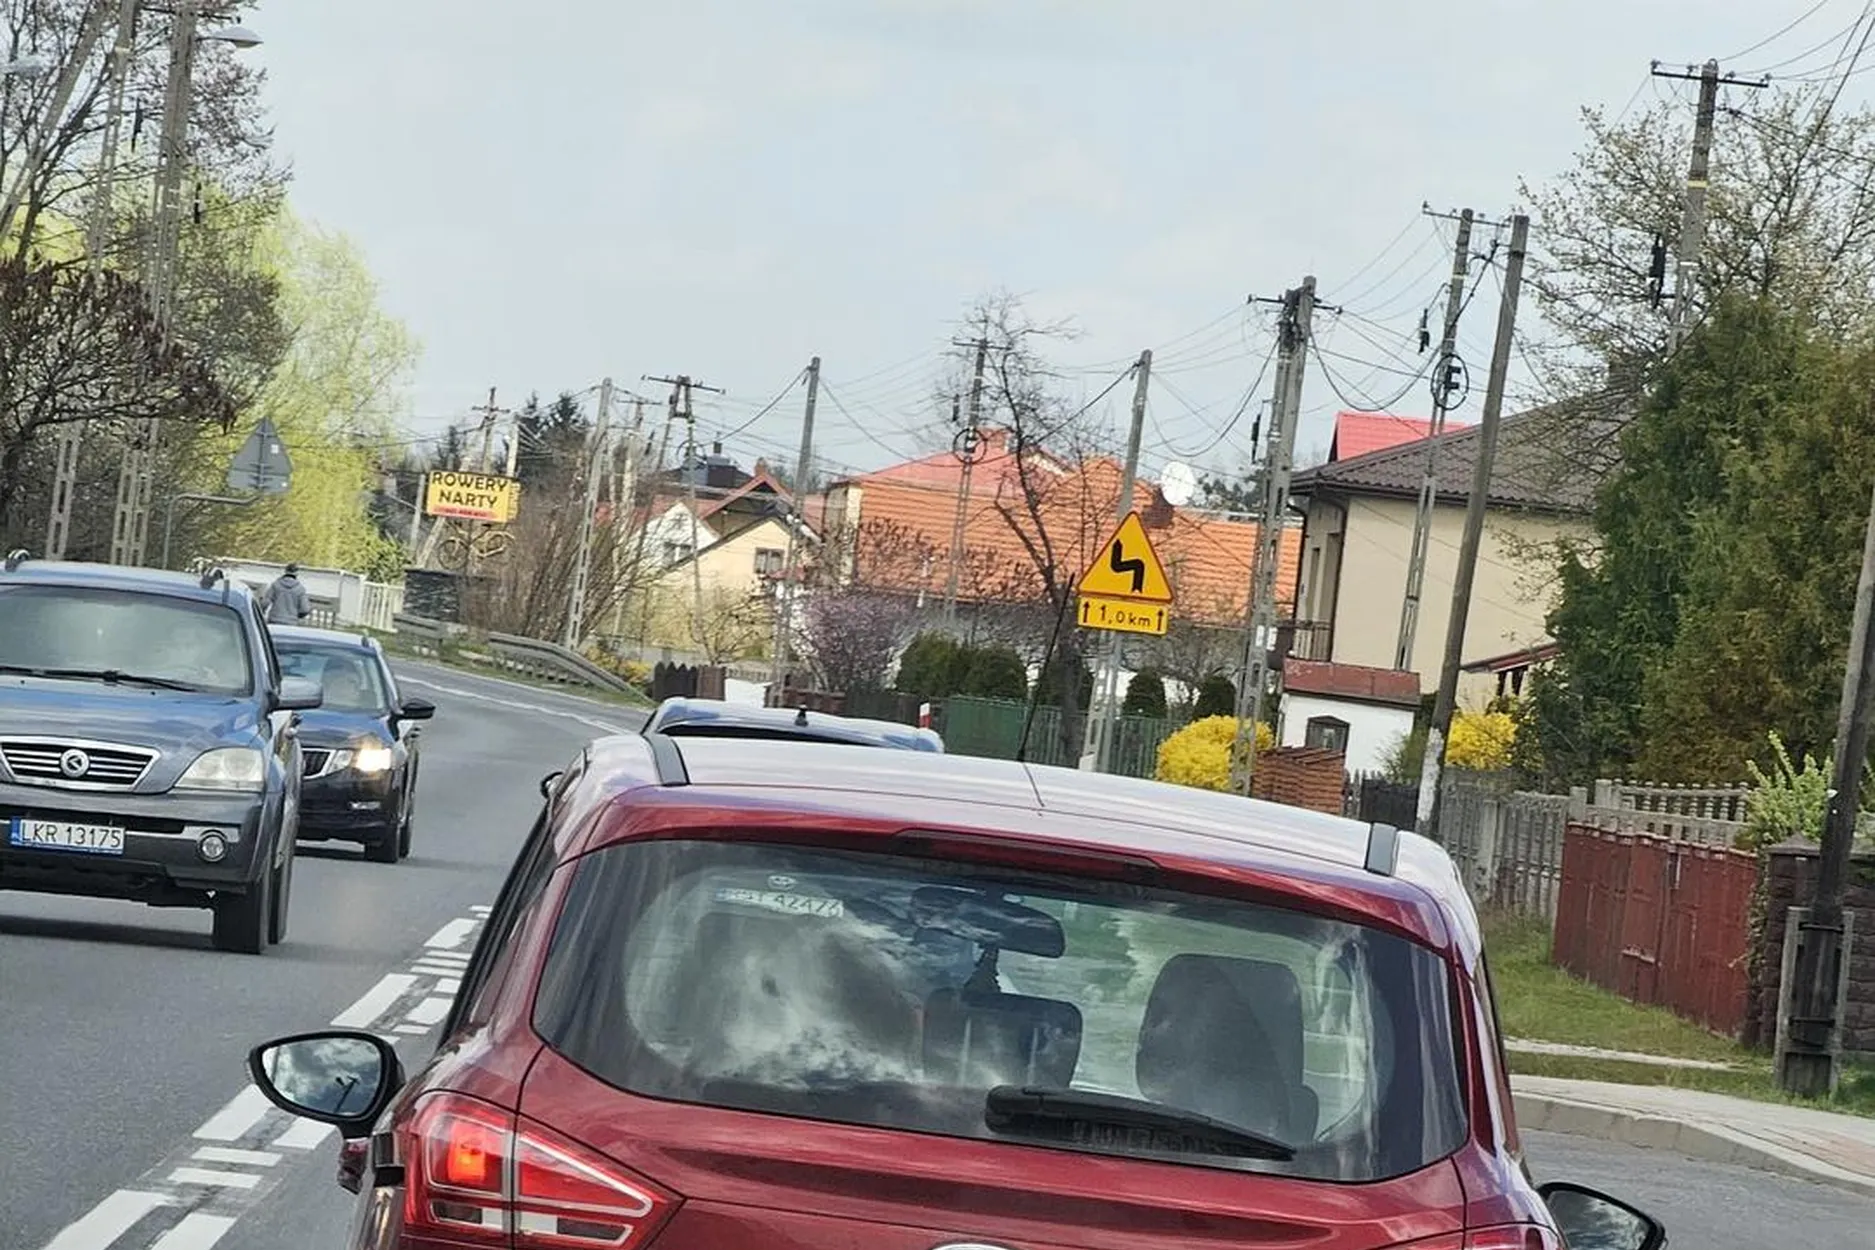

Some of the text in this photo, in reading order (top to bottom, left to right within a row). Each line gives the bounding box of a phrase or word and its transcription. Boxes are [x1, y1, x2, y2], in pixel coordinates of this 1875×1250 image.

[432, 471, 507, 492] ROWERY
[439, 490, 497, 508] NARTY
[21, 822, 58, 843] LKR
[66, 826, 121, 848] 13175
